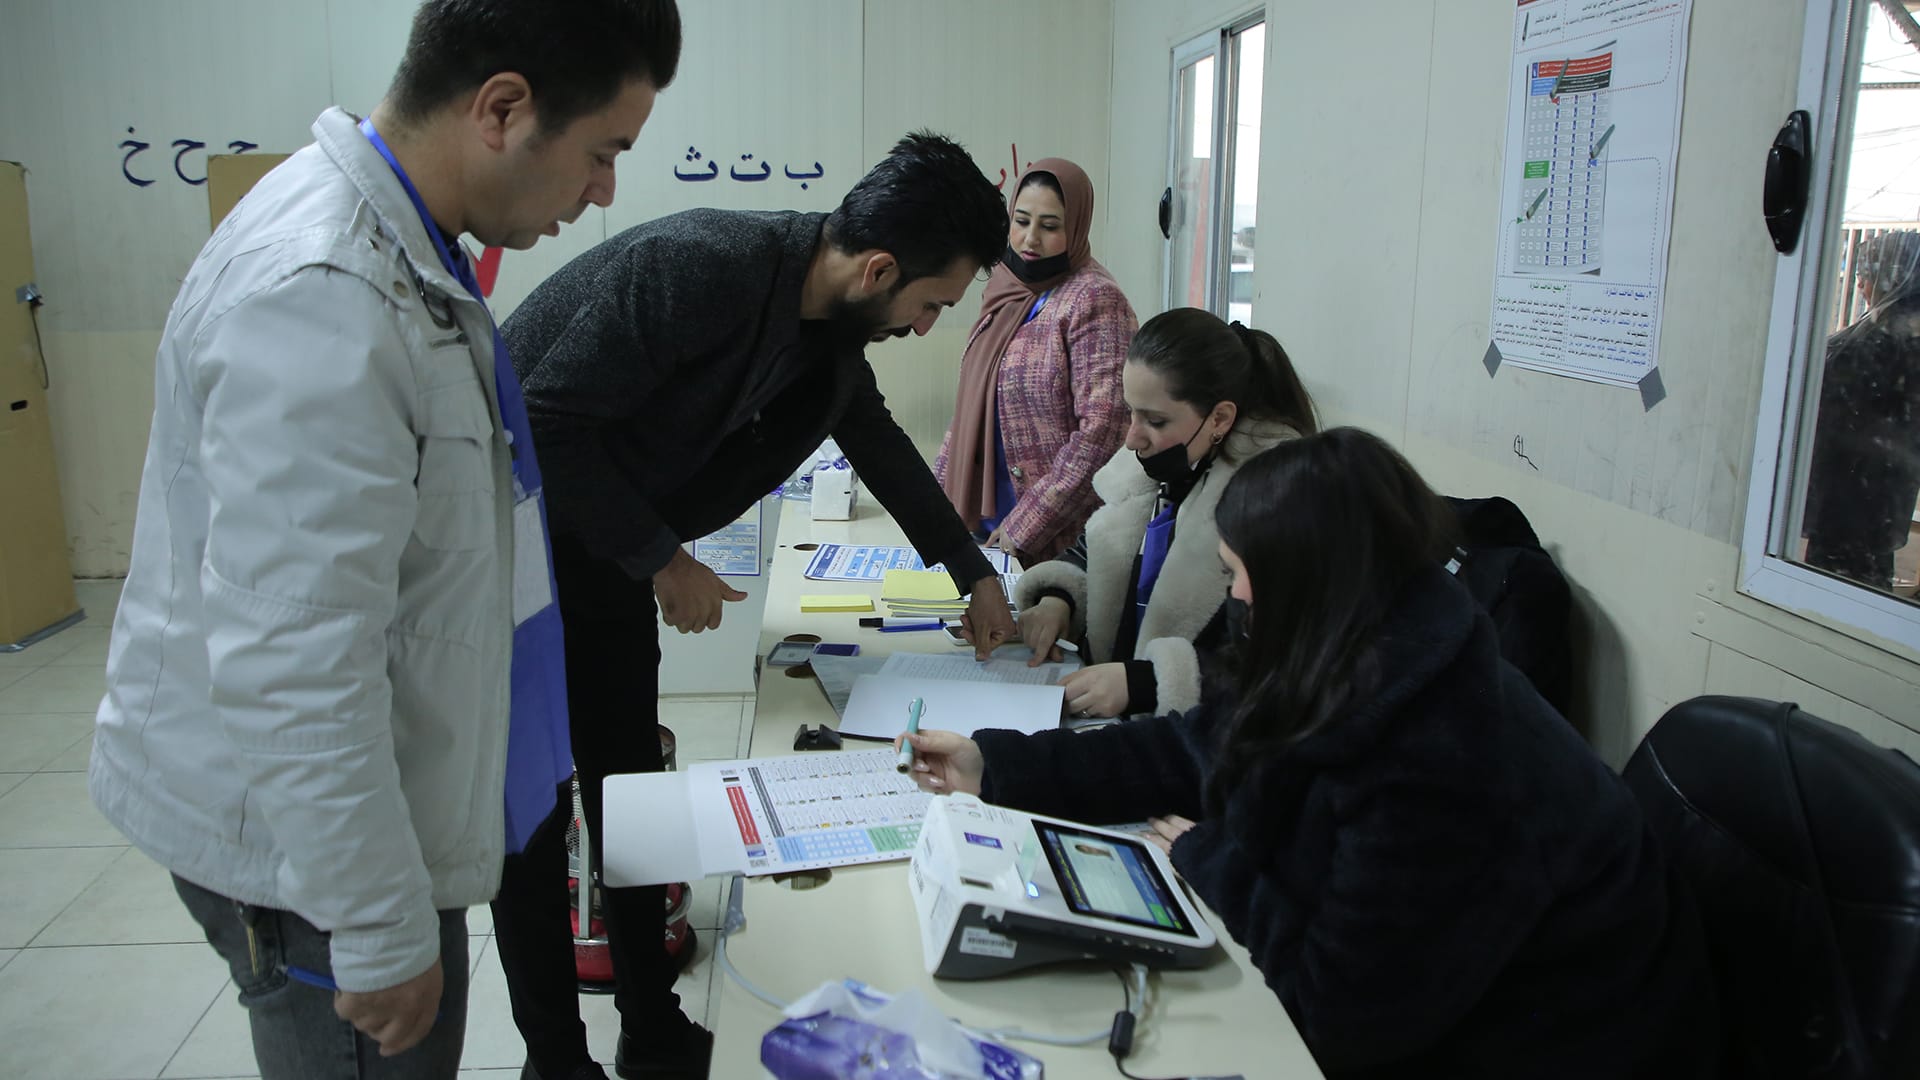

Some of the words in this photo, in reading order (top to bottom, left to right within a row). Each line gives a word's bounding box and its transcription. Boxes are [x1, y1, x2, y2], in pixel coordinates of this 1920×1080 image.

[119, 126, 156, 187] خ
[674, 146, 719, 182] ث
[730, 153, 771, 182] ت
[784, 161, 824, 191] ب
